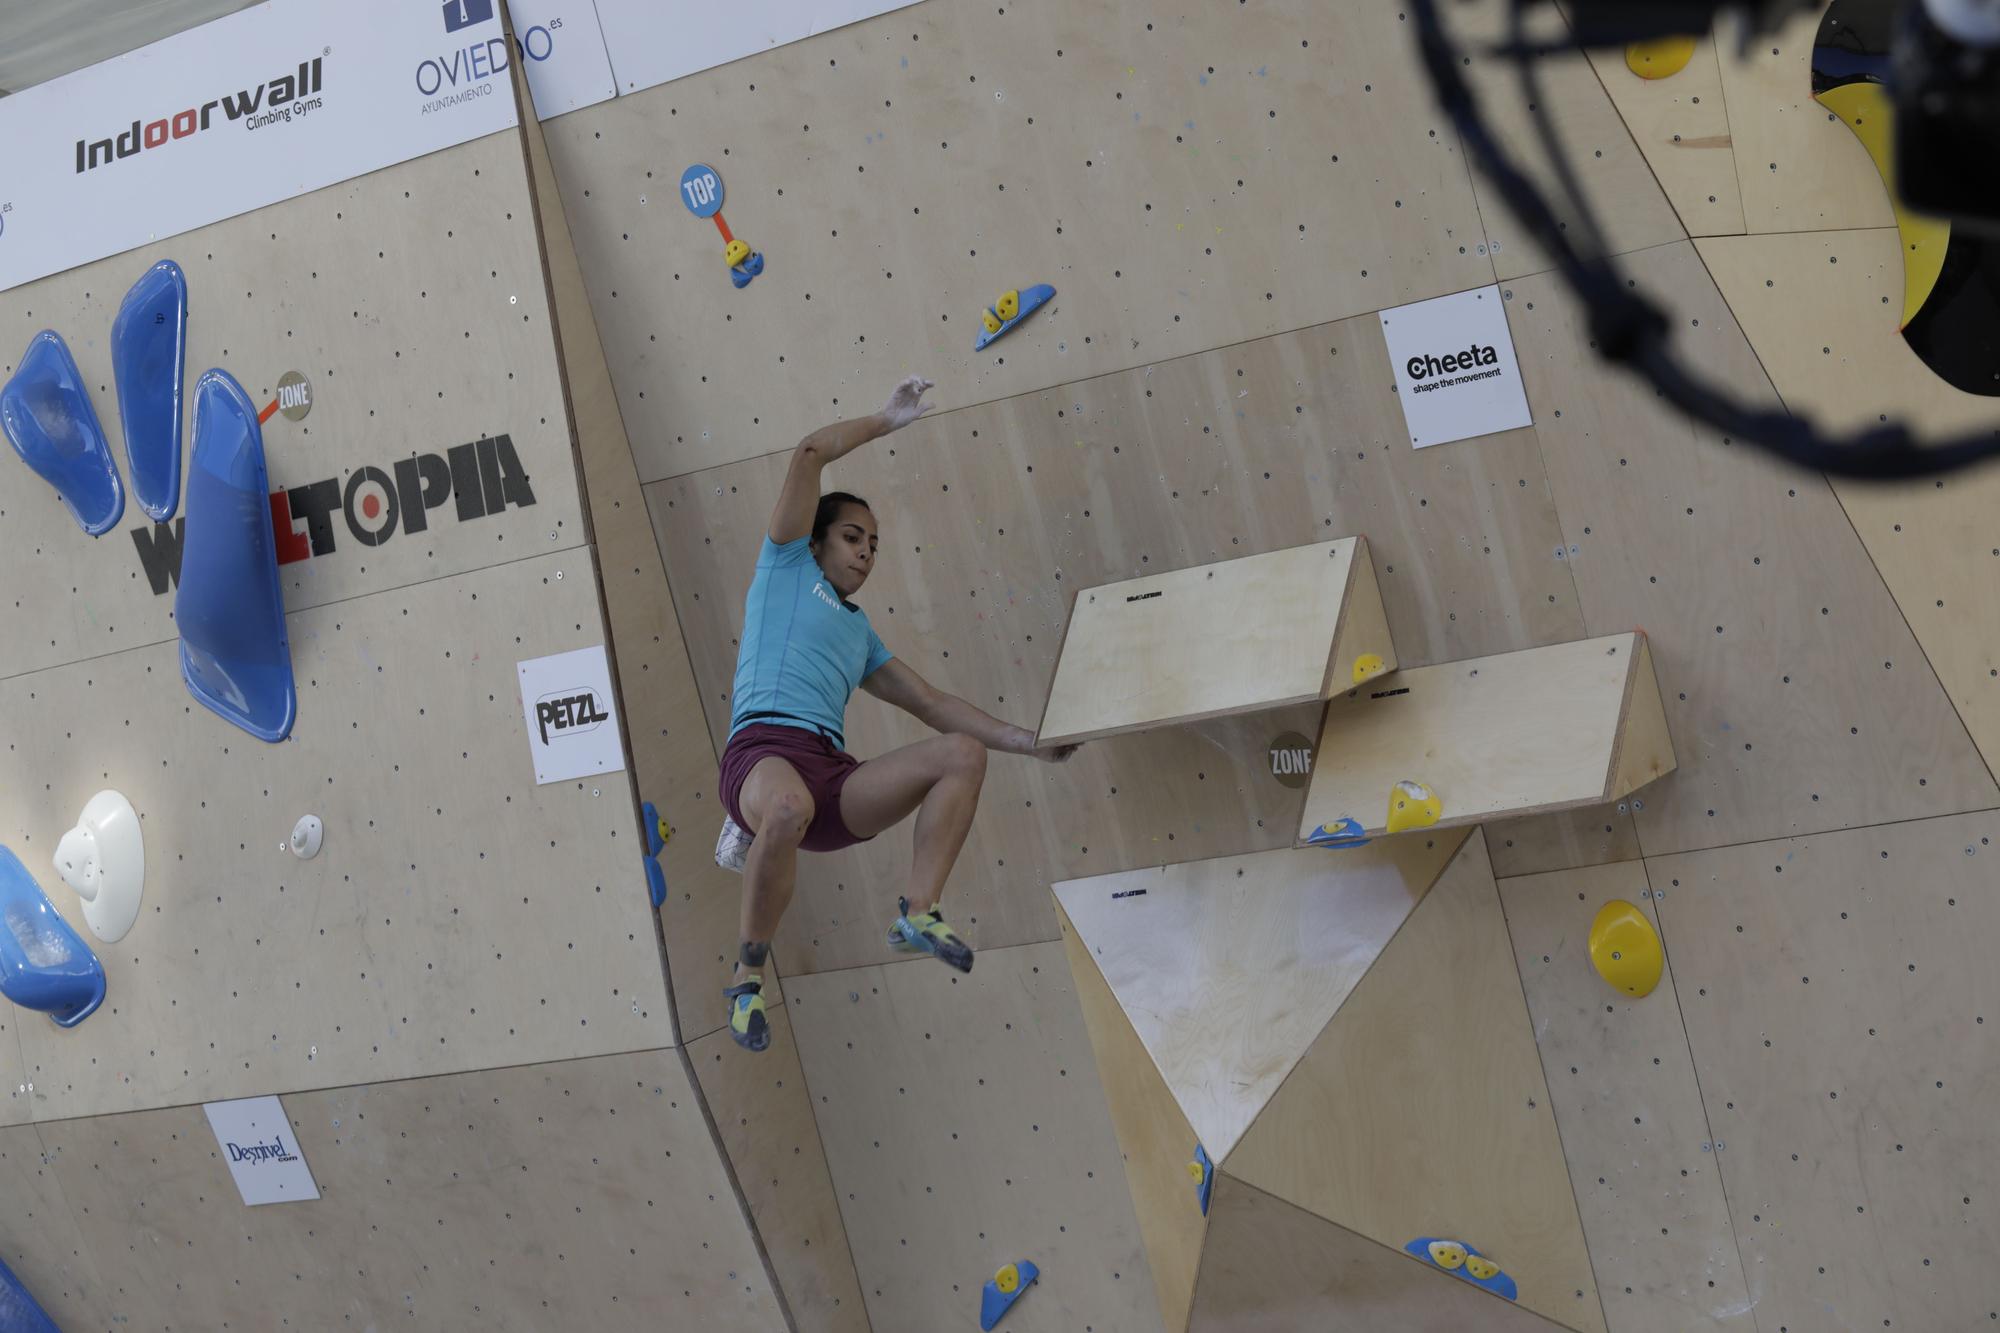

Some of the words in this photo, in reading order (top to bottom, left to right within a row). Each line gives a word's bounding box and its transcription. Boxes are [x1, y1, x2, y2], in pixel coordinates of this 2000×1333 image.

[76, 57, 322, 174] Indoorwall
[246, 106, 291, 131] Climbing
[293, 97, 322, 117] Gyms
[422, 83, 492, 115] AYUNTAMIENTO
[683, 173, 716, 208] TOP
[1407, 344, 1498, 380] Cheeta
[278, 382, 309, 409] ZONE
[1413, 382, 1439, 394] shape
[1440, 378, 1454, 388] the
[1455, 367, 1502, 385] movement
[536, 693, 609, 747] PETZL
